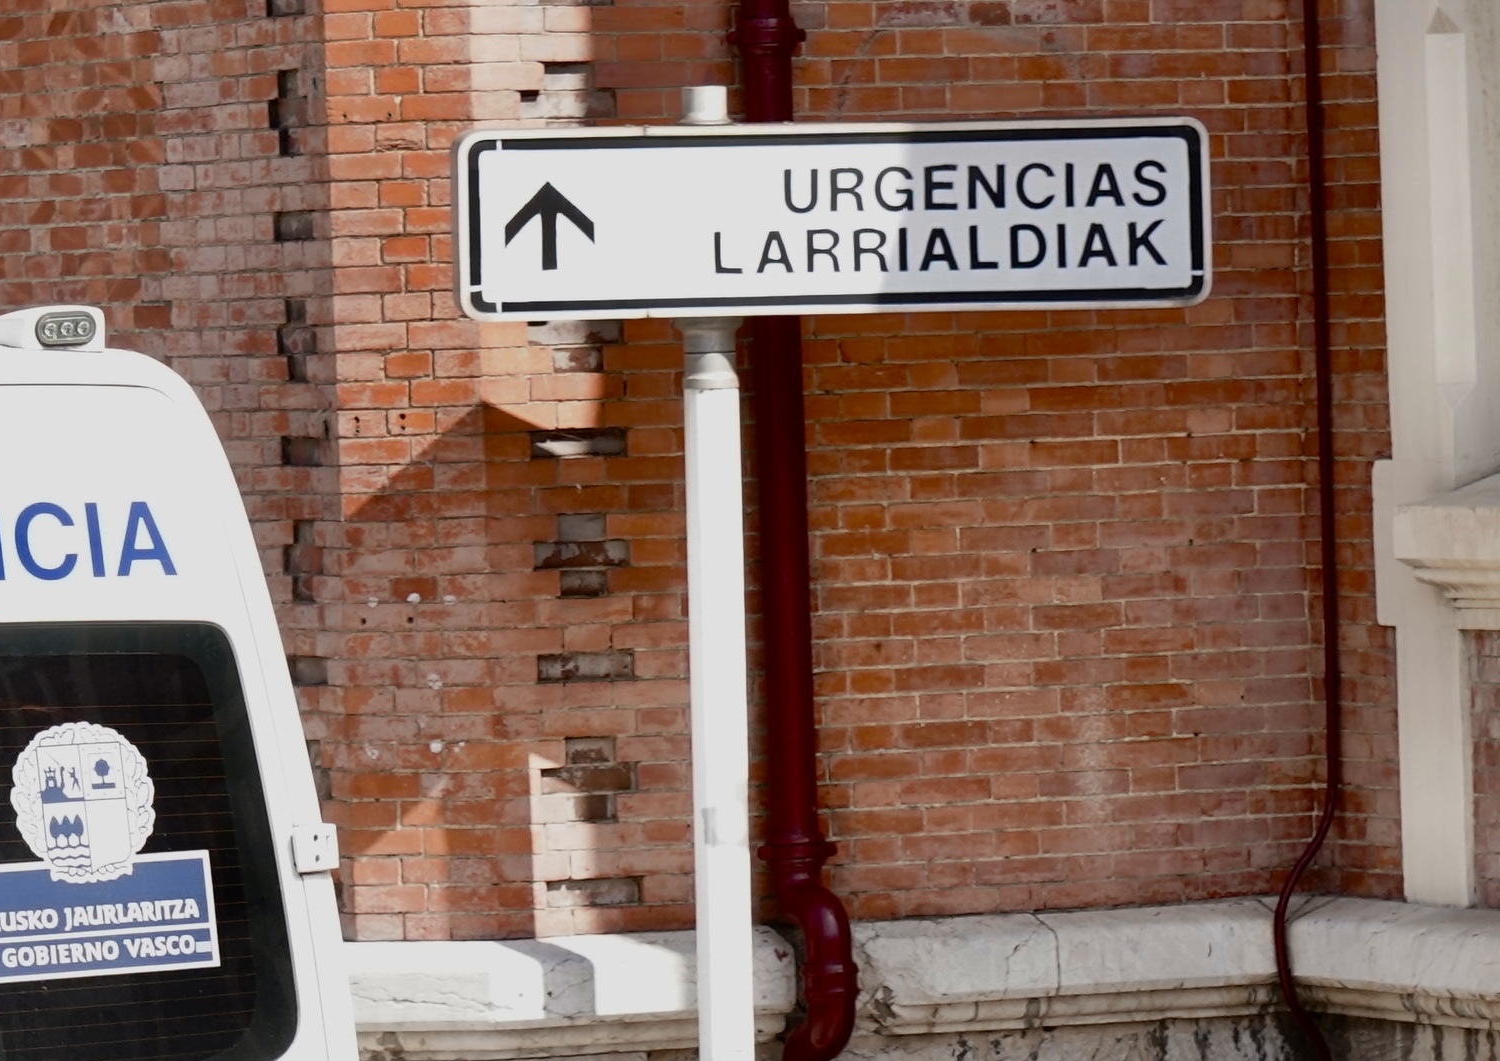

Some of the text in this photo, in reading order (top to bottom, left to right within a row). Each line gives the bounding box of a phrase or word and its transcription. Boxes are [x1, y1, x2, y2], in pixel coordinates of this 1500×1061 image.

[783, 159, 1168, 214] URGENCIAS
[714, 219, 1168, 275] LARRIALDIAK
[63, 897, 200, 932] JAURLARITZA
[1, 934, 197, 968] GOBIERNO VASCO
